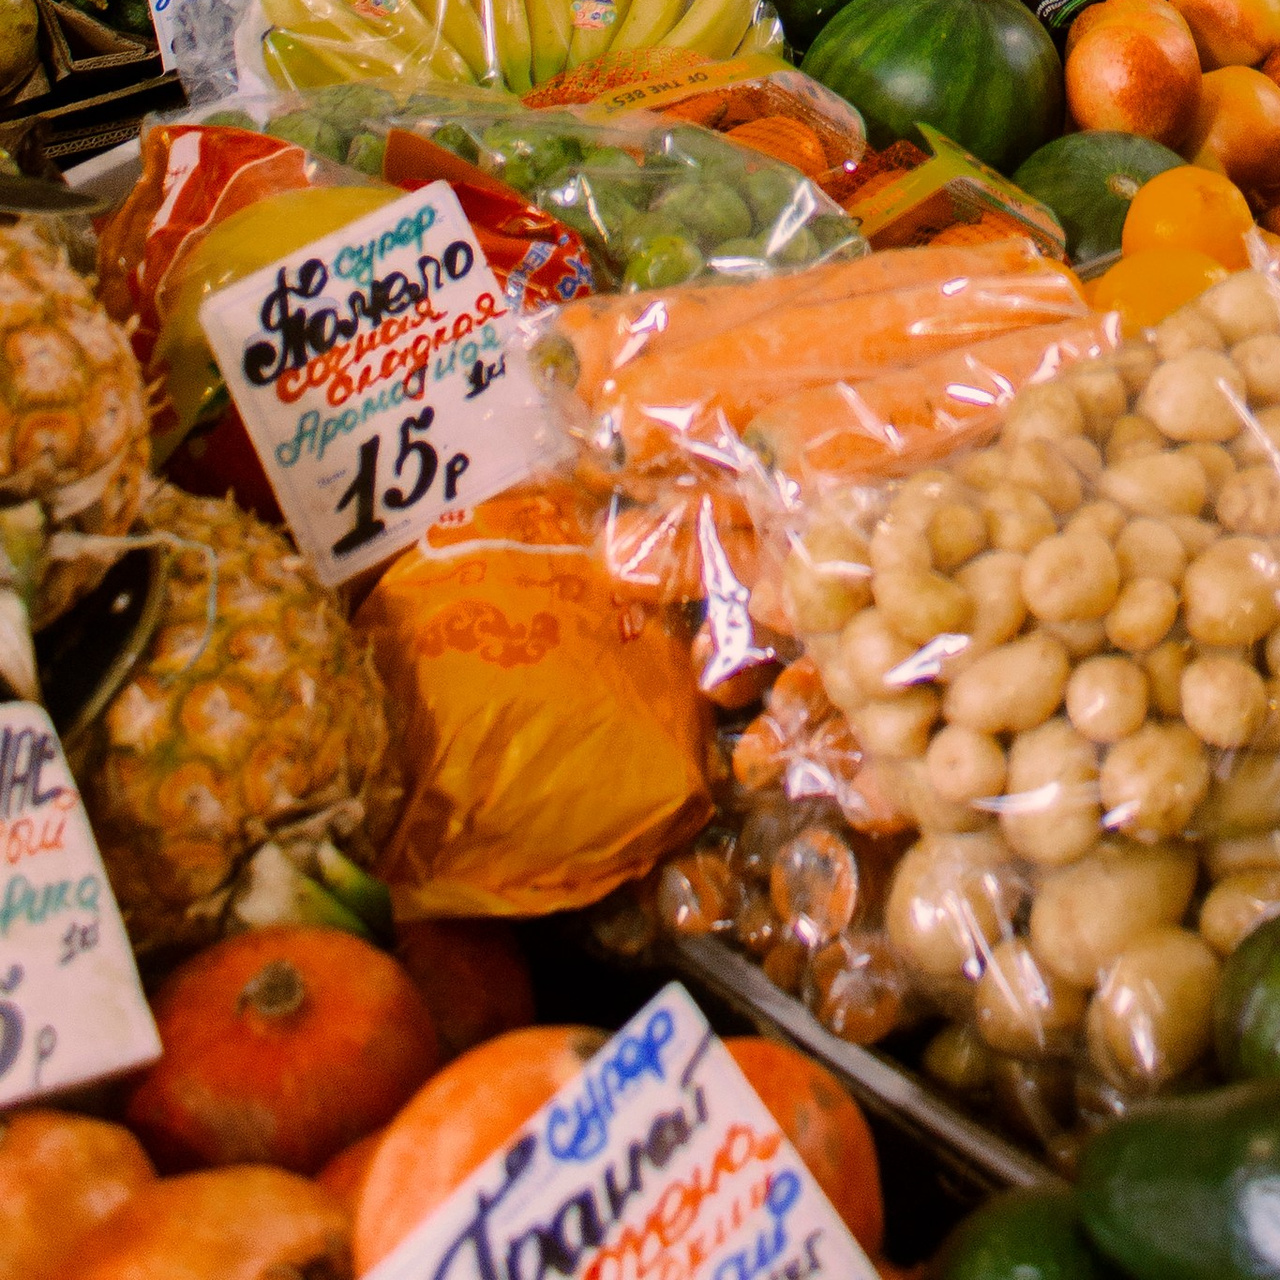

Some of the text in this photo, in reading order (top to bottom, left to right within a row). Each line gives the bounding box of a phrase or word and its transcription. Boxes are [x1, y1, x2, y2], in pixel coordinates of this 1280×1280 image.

[650, 77, 683, 98] THE
[683, 70, 709, 86] OF
[334, 205, 436, 286] супер
[243, 240, 474, 387] Помело
[546, 1008, 676, 1162] супер
